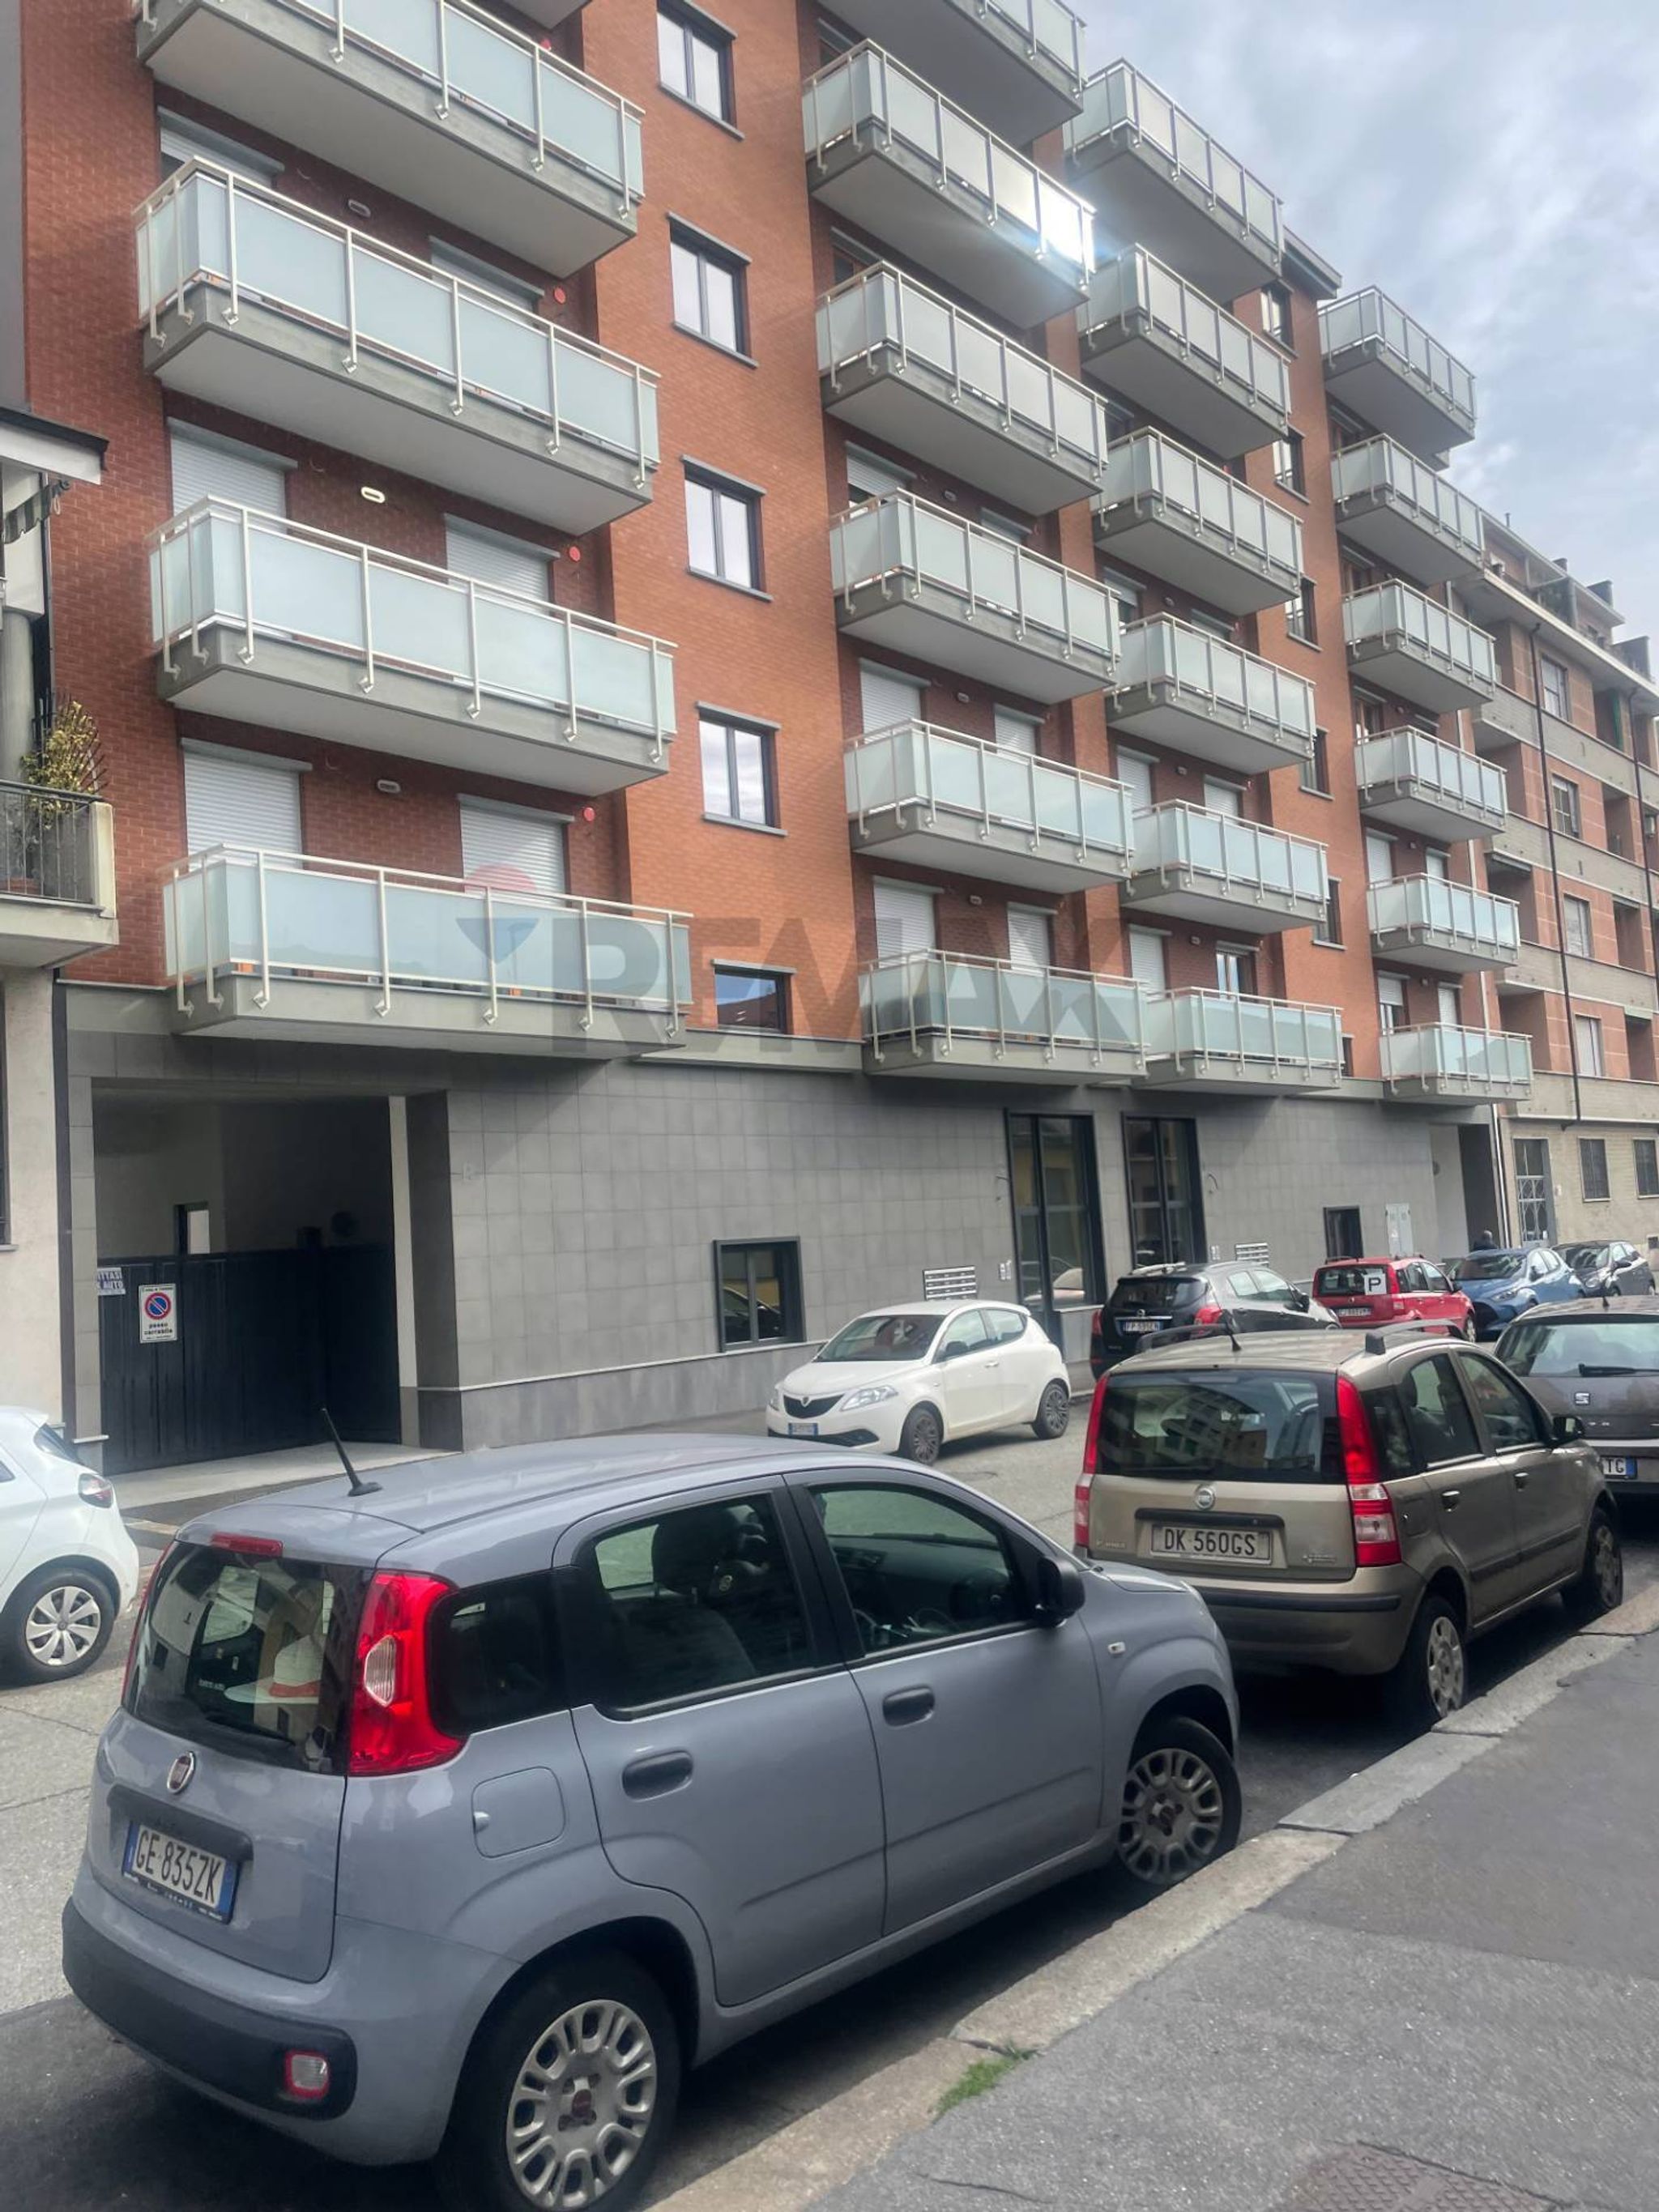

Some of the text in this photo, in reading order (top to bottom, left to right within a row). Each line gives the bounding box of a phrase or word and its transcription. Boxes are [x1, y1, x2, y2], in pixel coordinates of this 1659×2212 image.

[1368, 1276, 1381, 1292] P
[1164, 1528, 1256, 1556] DK 560GS
[136, 1830, 222, 1904] GE 835ZK
